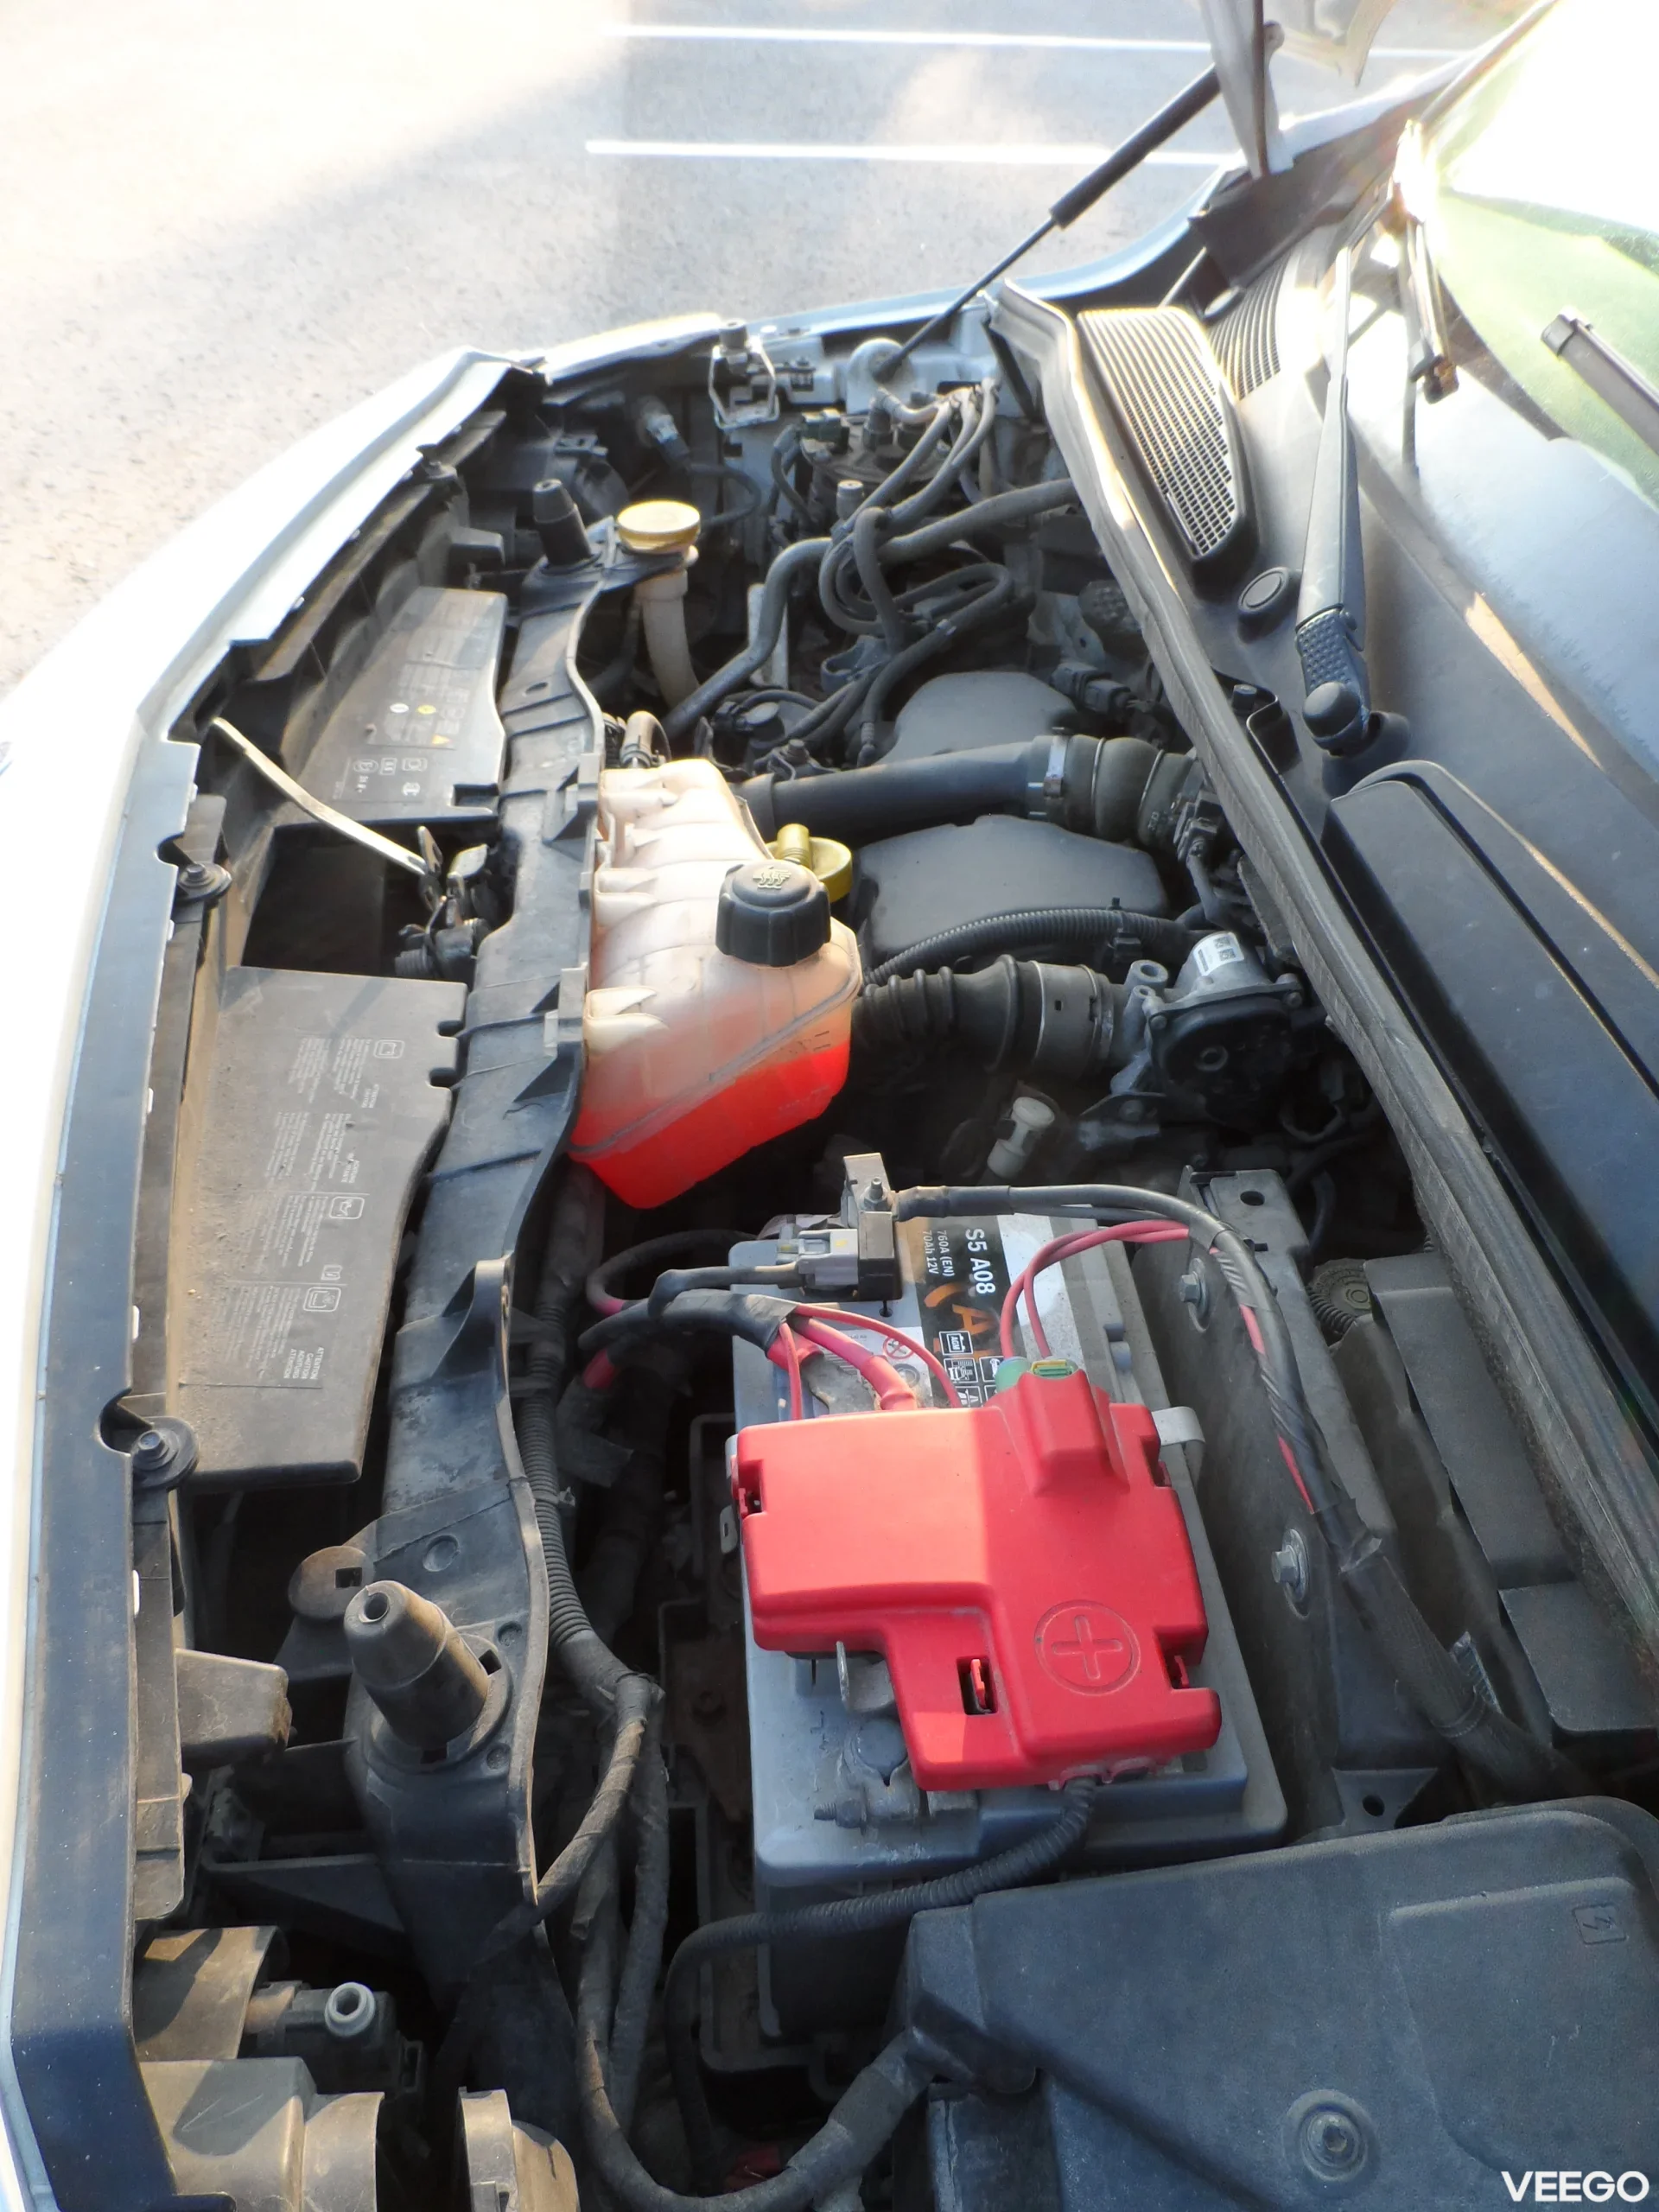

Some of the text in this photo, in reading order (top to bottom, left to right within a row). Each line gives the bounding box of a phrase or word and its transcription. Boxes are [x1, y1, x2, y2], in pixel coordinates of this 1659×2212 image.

[922, 1230, 939, 1274] 70Ah 12V
[937, 1230, 956, 1277] 760A (EN)
[965, 1228, 996, 1294] S5 A08
[950, 1336, 961, 1351] AGM
